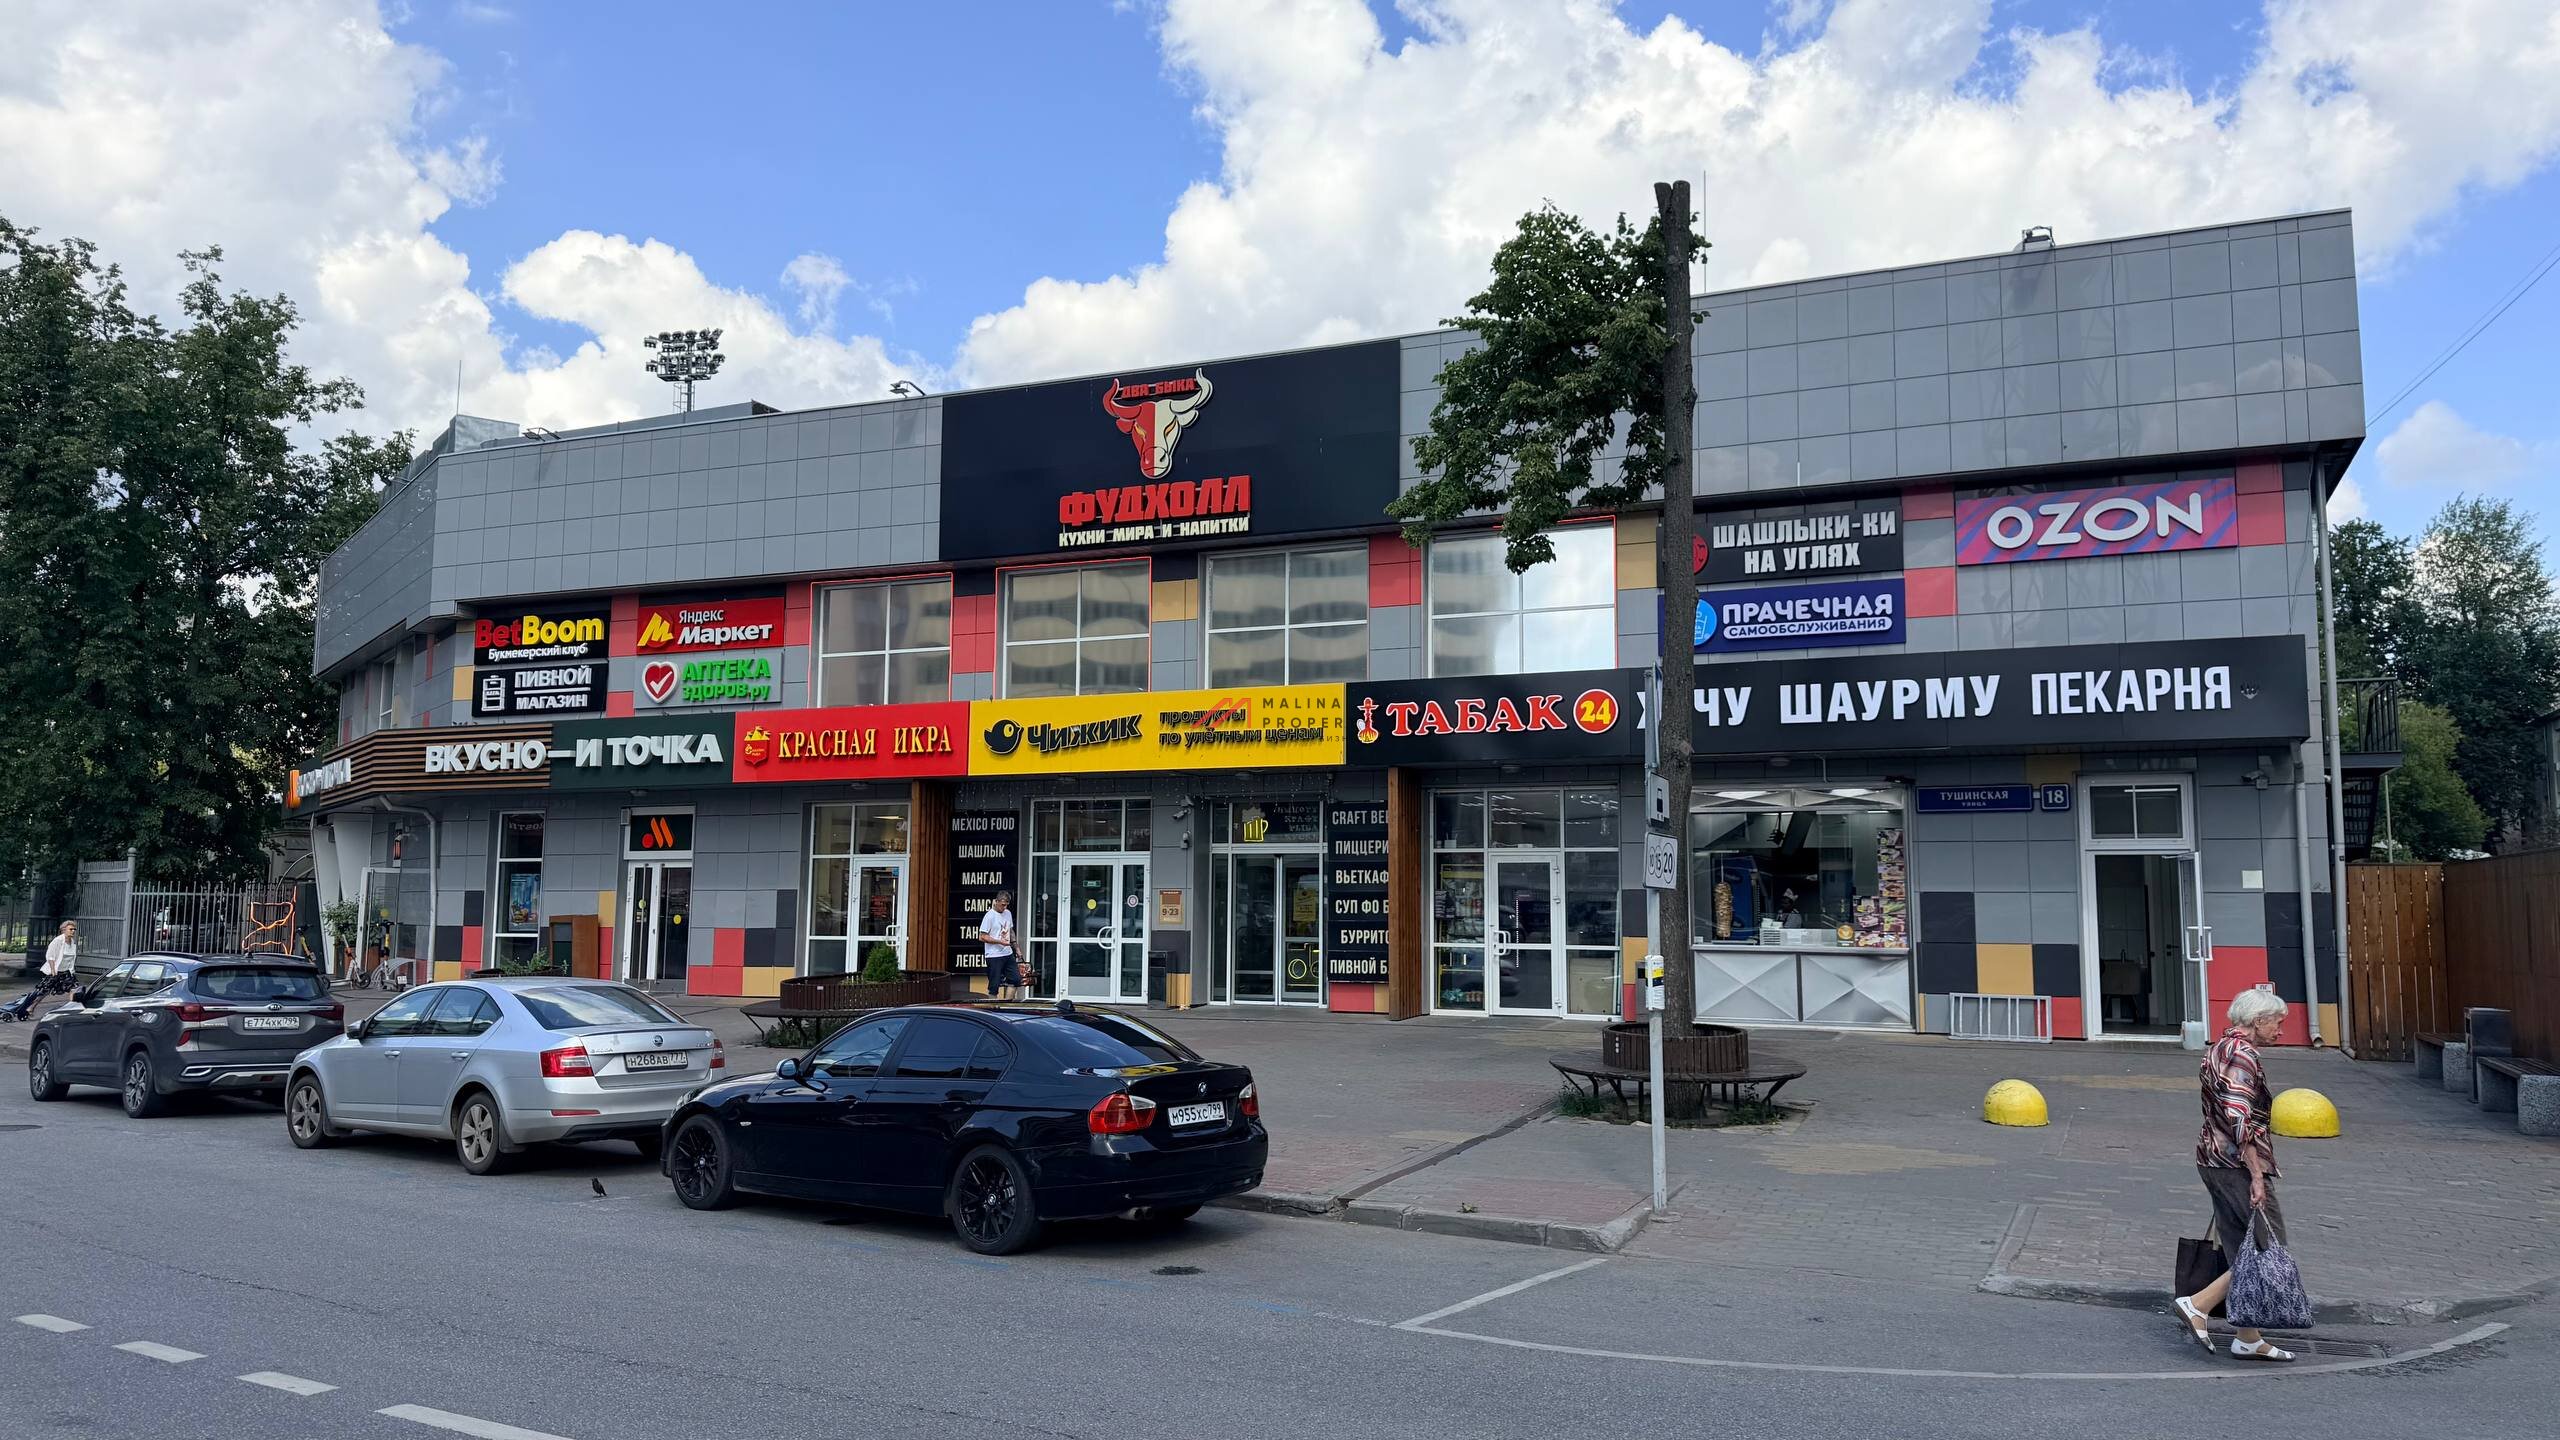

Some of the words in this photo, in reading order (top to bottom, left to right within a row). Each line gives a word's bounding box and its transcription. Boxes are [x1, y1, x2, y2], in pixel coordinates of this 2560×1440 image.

[1122, 384, 1149, 398] ДВА
[1155, 378, 1196, 395] БЫКА
[1060, 475, 1250, 526] ФУДХОЛЛ
[1059, 529, 1106, 547] КУХНИ
[1112, 525, 1154, 542] МИРА
[1162, 523, 1172, 538] И
[1180, 516, 1249, 536] НАПИТКИ
[1713, 511, 1896, 549] ШАШЛЫКИ-КИ
[1987, 493, 2203, 549] OZON
[1744, 549, 1776, 574] НА
[1783, 542, 1861, 571] УГЛЯХ
[679, 609, 725, 625] Яндекс
[1722, 594, 1893, 625] ПРАЧЕЧНАЯ
[475, 615, 605, 649] BetBoom
[678, 624, 773, 646] Маркет
[1729, 618, 1886, 637] САМООБСЛУЖИВАНИЯ
[488, 645, 561, 662] Букмекерский
[561, 642, 588, 657] клуб
[514, 665, 592, 689] ПИВНОЙ
[682, 658, 771, 682] АПТЕКА
[516, 694, 588, 710] МАГАЗИН
[1779, 674, 2000, 725] ШАУРМУ
[2031, 666, 2231, 715] ПЕКАРНЯ
[1159, 708, 1246, 726] продукты
[1386, 694, 1568, 737] ТАБАК
[1579, 698, 1612, 725] 24
[778, 728, 877, 758] КРАСНАЯ
[893, 725, 952, 754] ИКРА
[1027, 714, 1143, 753] Чижик
[1159, 731, 1181, 746] по
[1185, 727, 1262, 748] улётным
[1265, 727, 1324, 745] ценам
[607, 733, 724, 767] ТОЧКА
[1940, 790, 2009, 801] ТУШИНСКАЯ
[2046, 790, 2065, 804] 18
[952, 818, 988, 831] MEXICO
[991, 817, 1015, 831] FOOD
[1332, 810, 1368, 825] CRAFT
[958, 844, 1005, 858] ШАШЛЫК
[1664, 852, 1673, 874] 20
[962, 872, 1003, 885] МАНГАЛ
[1335, 899, 1358, 914] СУП
[1361, 899, 1379, 914] ФО
[1330, 957, 1377, 974] ПИВНОЙ
[1380, 959, 1389, 974] Б
